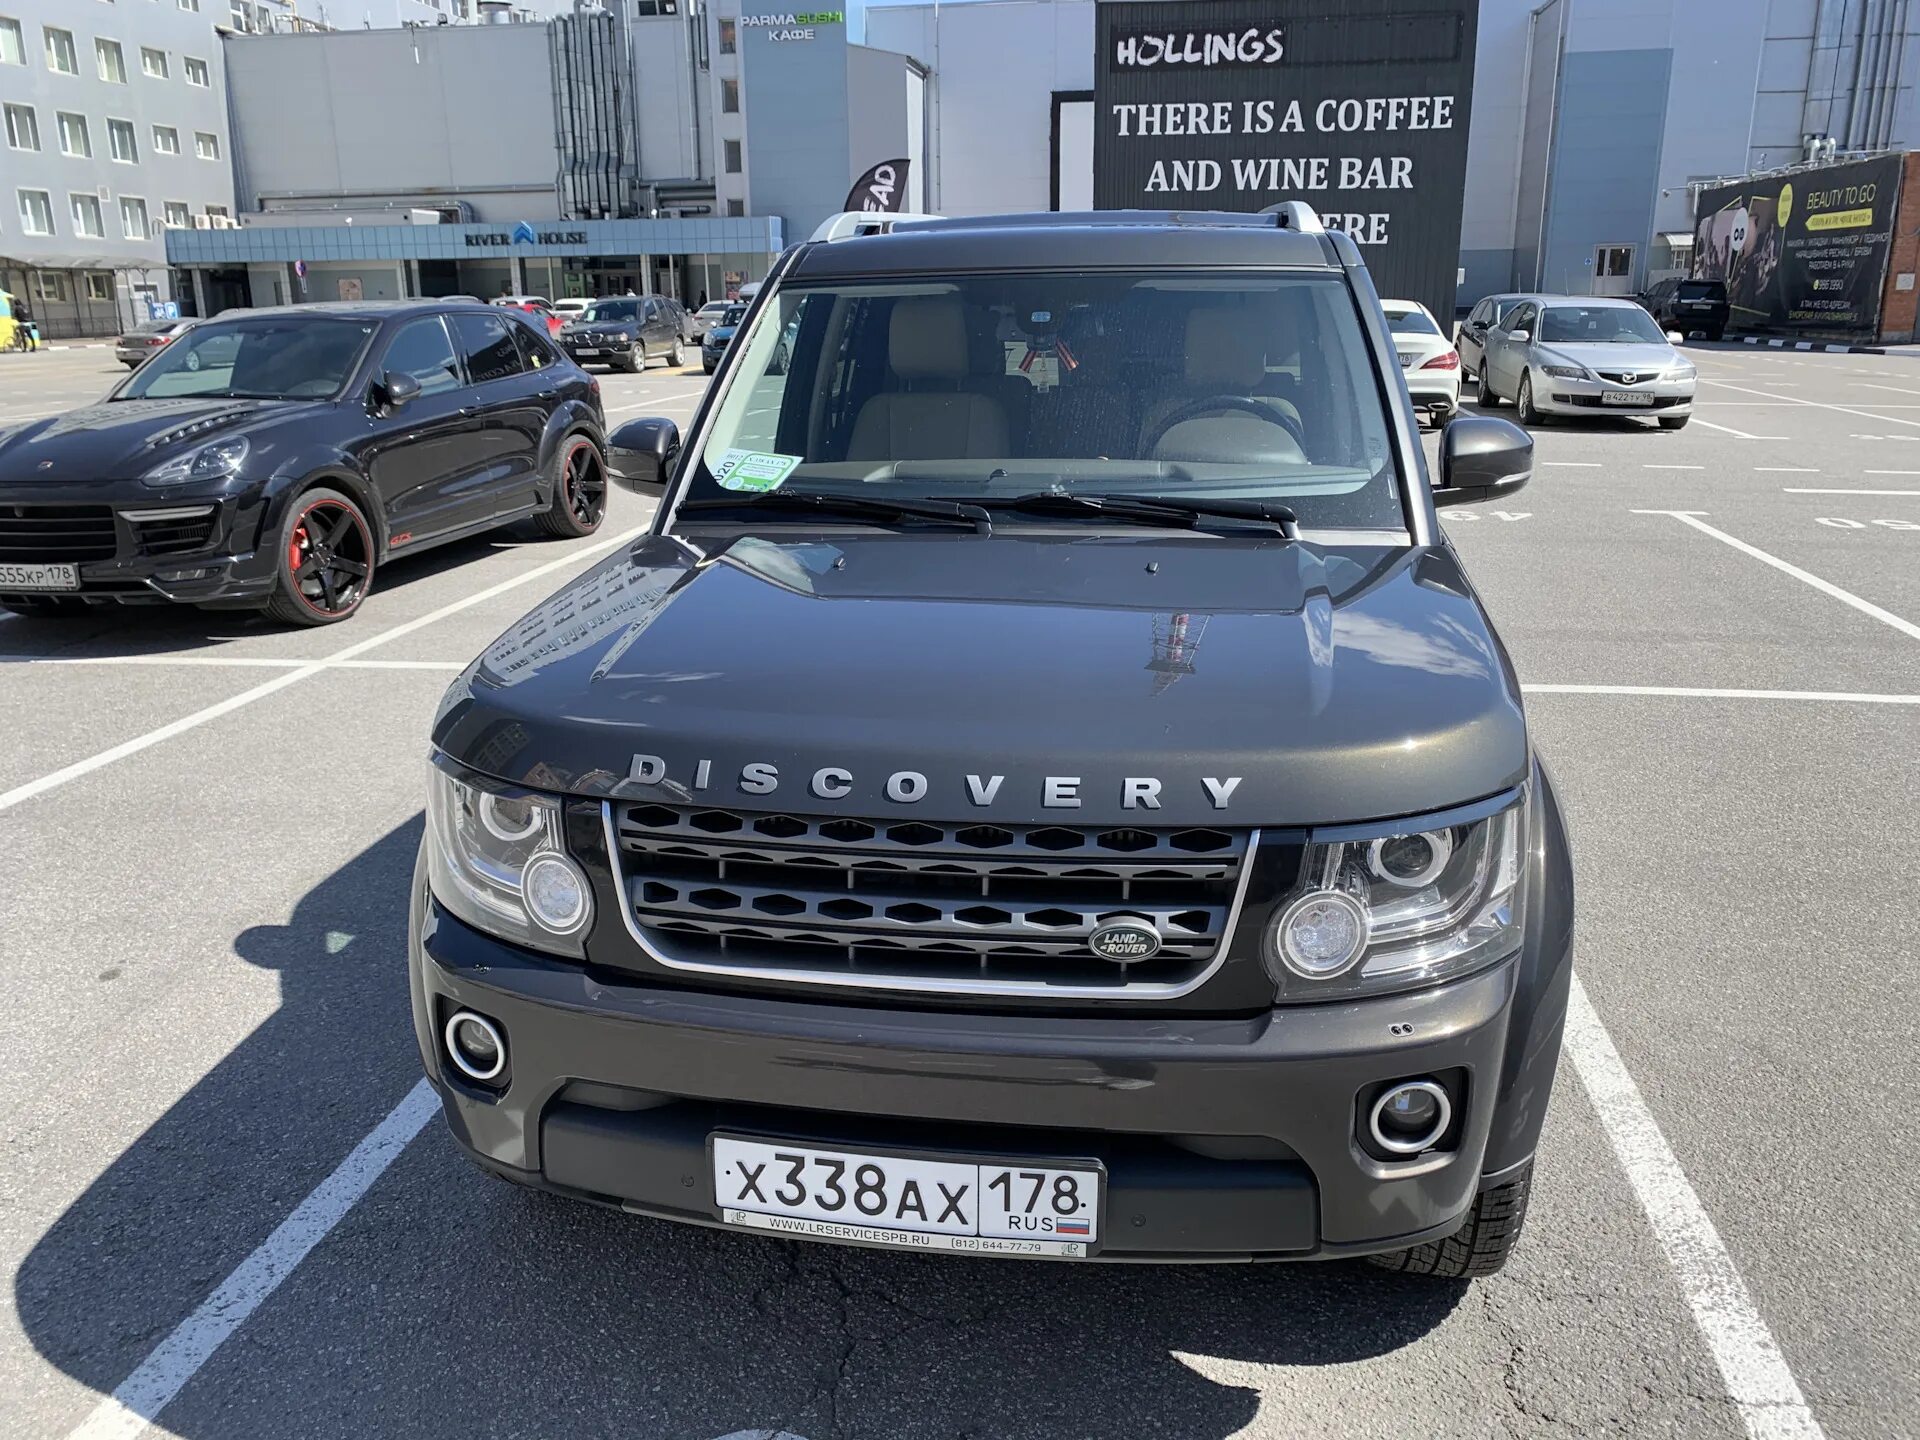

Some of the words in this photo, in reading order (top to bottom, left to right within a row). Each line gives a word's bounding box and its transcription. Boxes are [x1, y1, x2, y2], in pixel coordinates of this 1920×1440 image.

[768, 29, 815, 41] КАФЕ
[1117, 28, 1284, 66] HOLLINGS
[1113, 102, 1232, 136] THERE
[1241, 100, 1275, 134] IS
[1279, 100, 1305, 133] A
[1315, 96, 1454, 132] COFFEE
[1144, 160, 1222, 192] AND
[1231, 157, 1329, 191] WINE
[1338, 157, 1414, 189] BAR
[1807, 188, 1843, 210] BEAUTY
[1845, 186, 1858, 205] TO
[1860, 183, 1876, 203] GO
[465, 234, 511, 246] RIVER
[538, 232, 588, 244] HOUSE
[1316, 213, 1390, 245] ERE
[47, 567, 71, 580] 178
[629, 753, 1243, 809] DISCOVERY
[1104, 934, 1137, 943] LAND
[1107, 944, 1147, 953] ROVER
[735, 1153, 969, 1225] Х338АХ
[988, 1172, 1079, 1215] 178
[769, 1218, 930, 1246] WWW.LRSERVICESPB.RU
[982, 1240, 1041, 1252] 644-77-79
[1009, 1216, 1053, 1231] RUS
